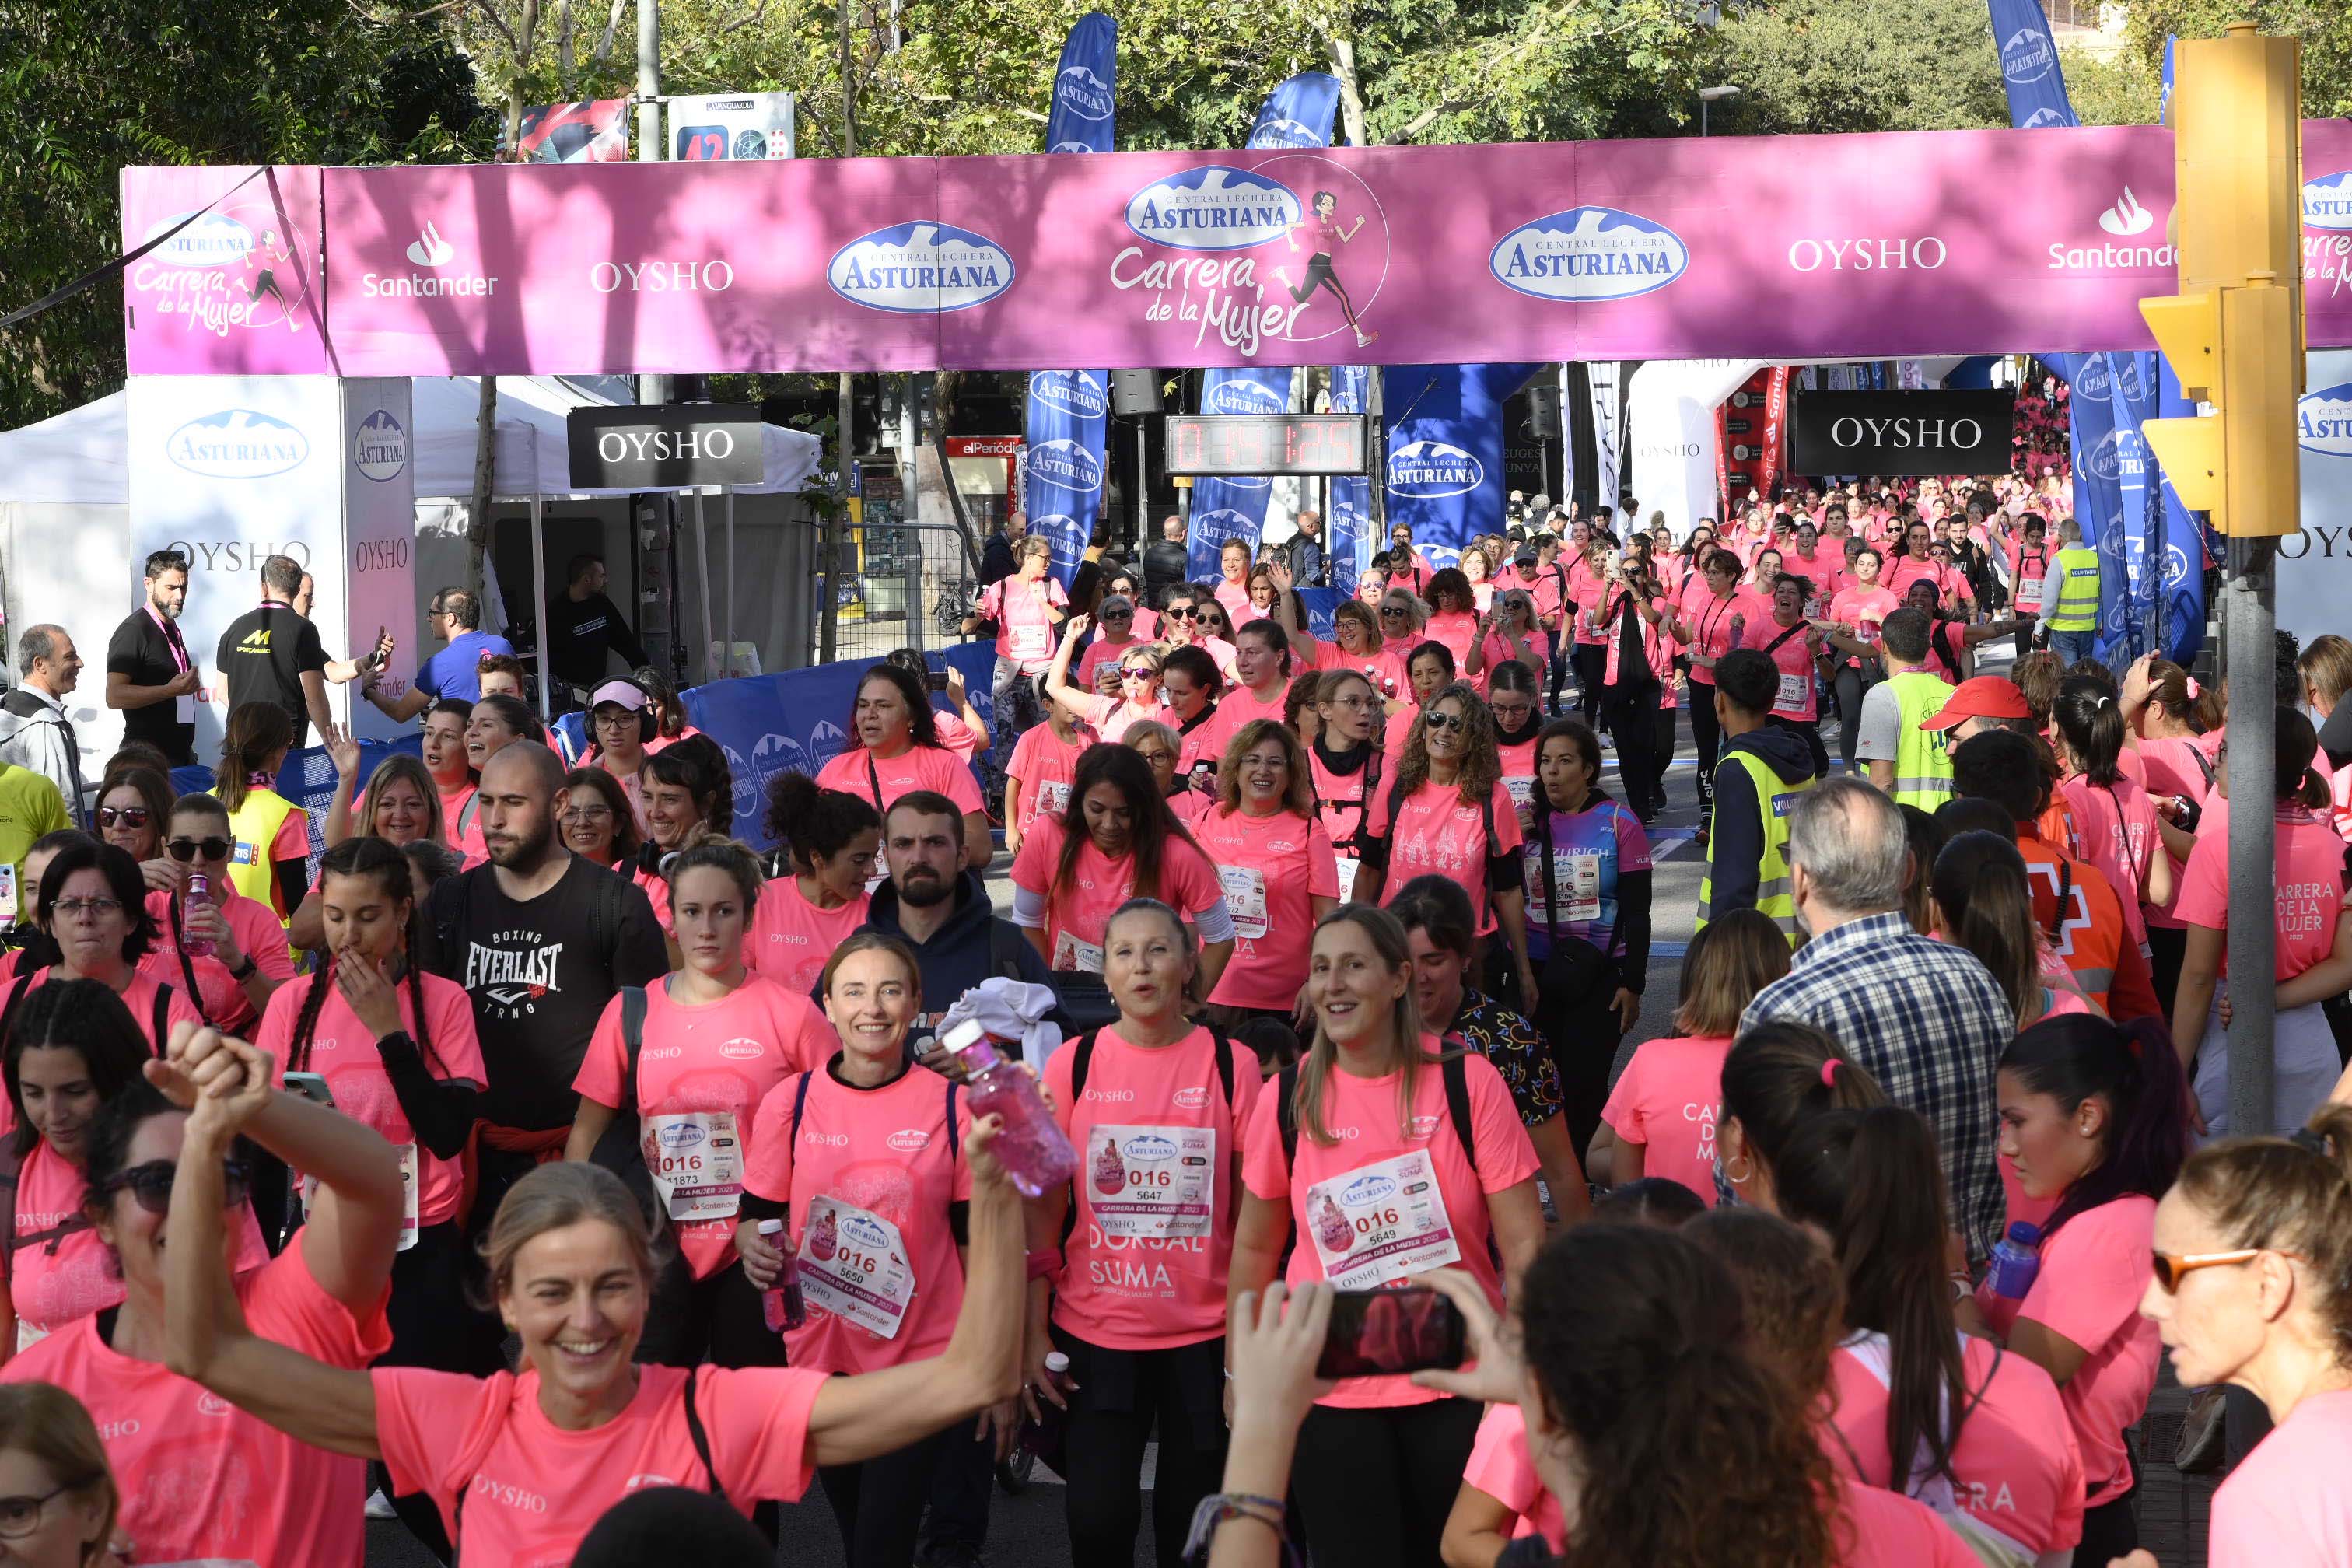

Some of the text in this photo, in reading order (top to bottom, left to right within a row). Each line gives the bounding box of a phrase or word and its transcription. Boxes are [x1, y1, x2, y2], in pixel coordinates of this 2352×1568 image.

[1166, 194, 1283, 203] CENTRAL LECHERA
[1138, 198, 1288, 229] ASTURIANA
[1536, 238, 1667, 250] CENTRAL LECHERA
[1789, 236, 1946, 271] OYSHO
[870, 252, 994, 262] CENTRAL LECHERA
[1111, 246, 1258, 289] Carrera
[1505, 243, 1673, 278] ASTURIANA
[134, 262, 226, 292] Carrera
[590, 260, 733, 293] OYSHO
[842, 255, 999, 289] ASTURIANA
[2320, 257, 2336, 280] la
[362, 273, 499, 297] Santander
[157, 288, 261, 338] de la Mujer
[1146, 284, 1311, 357] de la Mujer
[1038, 377, 1101, 413] ASTURIANA
[1831, 417, 1982, 450] OYSHO
[178, 435, 299, 461] ASTURIANA
[359, 442, 403, 464] ASTURIANA
[598, 429, 733, 463] OYSHO
[1031, 450, 1097, 486] ASTURIANA
[1388, 464, 1476, 486] ASTURIANA
[1505, 465, 1541, 474] UNYA
[1198, 522, 1255, 547] ASTURIANA
[166, 541, 311, 572] OYSHO
[355, 537, 408, 572] OYSHO
[1213, 837, 1243, 845] OYSHO
[1552, 847, 1609, 859] ZURICH
[2276, 882, 2334, 901] ARRERA
[2278, 899, 2320, 916] DE LA
[2280, 916, 2322, 934] UJER
[492, 929, 542, 943] BOXING
[770, 933, 808, 946] OYSHO
[155, 945, 178, 954] SHO
[465, 940, 563, 991] EVERLAST
[485, 1003, 535, 1019] TRNG
[310, 1039, 337, 1050] SHO
[1085, 1089, 1135, 1102] OYSHO
[661, 1132, 702, 1142] ASTURIANA
[805, 1132, 849, 1147] OYSHO
[1307, 1126, 1360, 1140] SHO
[1128, 1144, 1174, 1156] ASTURIANA
[662, 1155, 702, 1172] 016
[667, 1174, 698, 1185] 11873
[1129, 1170, 1171, 1186] 016
[1136, 1191, 1162, 1200] 5647
[1346, 1184, 1392, 1203] ASTURIANA
[700, 1202, 738, 1211] Santander
[15, 1211, 68, 1227] OYSHO
[1101, 1218, 1136, 1228] OYSHO
[1164, 1220, 1202, 1230] Santander
[1356, 1208, 1399, 1234] 016
[842, 1219, 886, 1247] ASTURIANA
[1370, 1230, 1397, 1246] 5649
[838, 1246, 877, 1273] 016
[1339, 1234, 1439, 1271] CARRERA DE LA MUJER 2023
[1408, 1248, 1447, 1265] Santander
[807, 1265, 835, 1285] CARRERA
[835, 1277, 845, 1288] DE
[845, 1283, 855, 1293] LA
[854, 1287, 877, 1304] MUJER
[840, 1266, 863, 1284] 5650
[1090, 1260, 1171, 1289] SUMA
[1342, 1267, 1380, 1289] OYSHO
[800, 1279, 831, 1300] OYSHO
[856, 1305, 890, 1326] Santander
[473, 1473, 547, 1513] OYSHO
